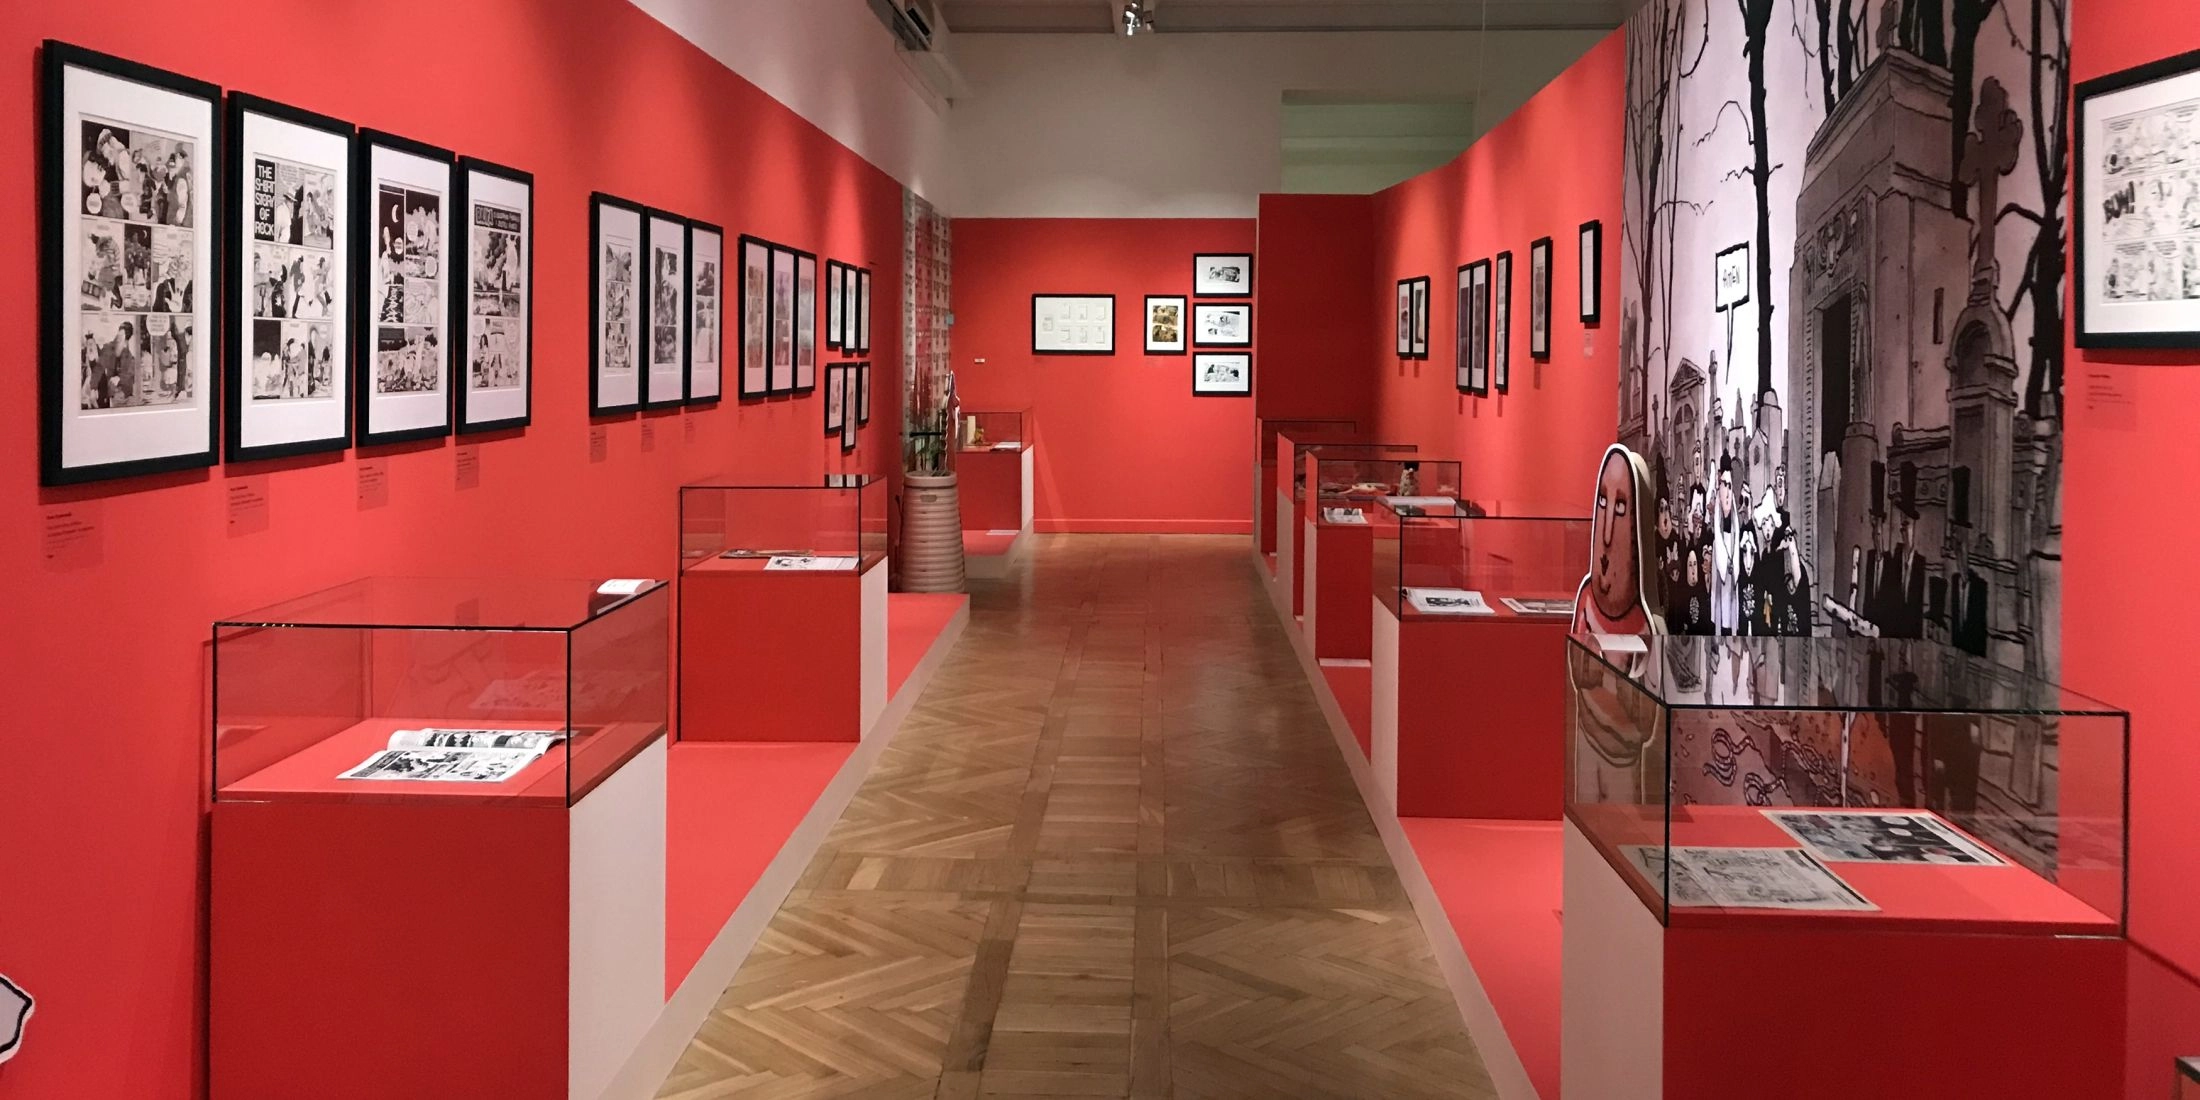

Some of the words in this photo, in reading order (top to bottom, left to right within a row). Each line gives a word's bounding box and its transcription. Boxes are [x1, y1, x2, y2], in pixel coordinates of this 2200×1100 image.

[257, 165, 272, 179] THE
[255, 193, 275, 208] STORY
[259, 207, 270, 221] OF
[254, 221, 275, 236] ROCK
